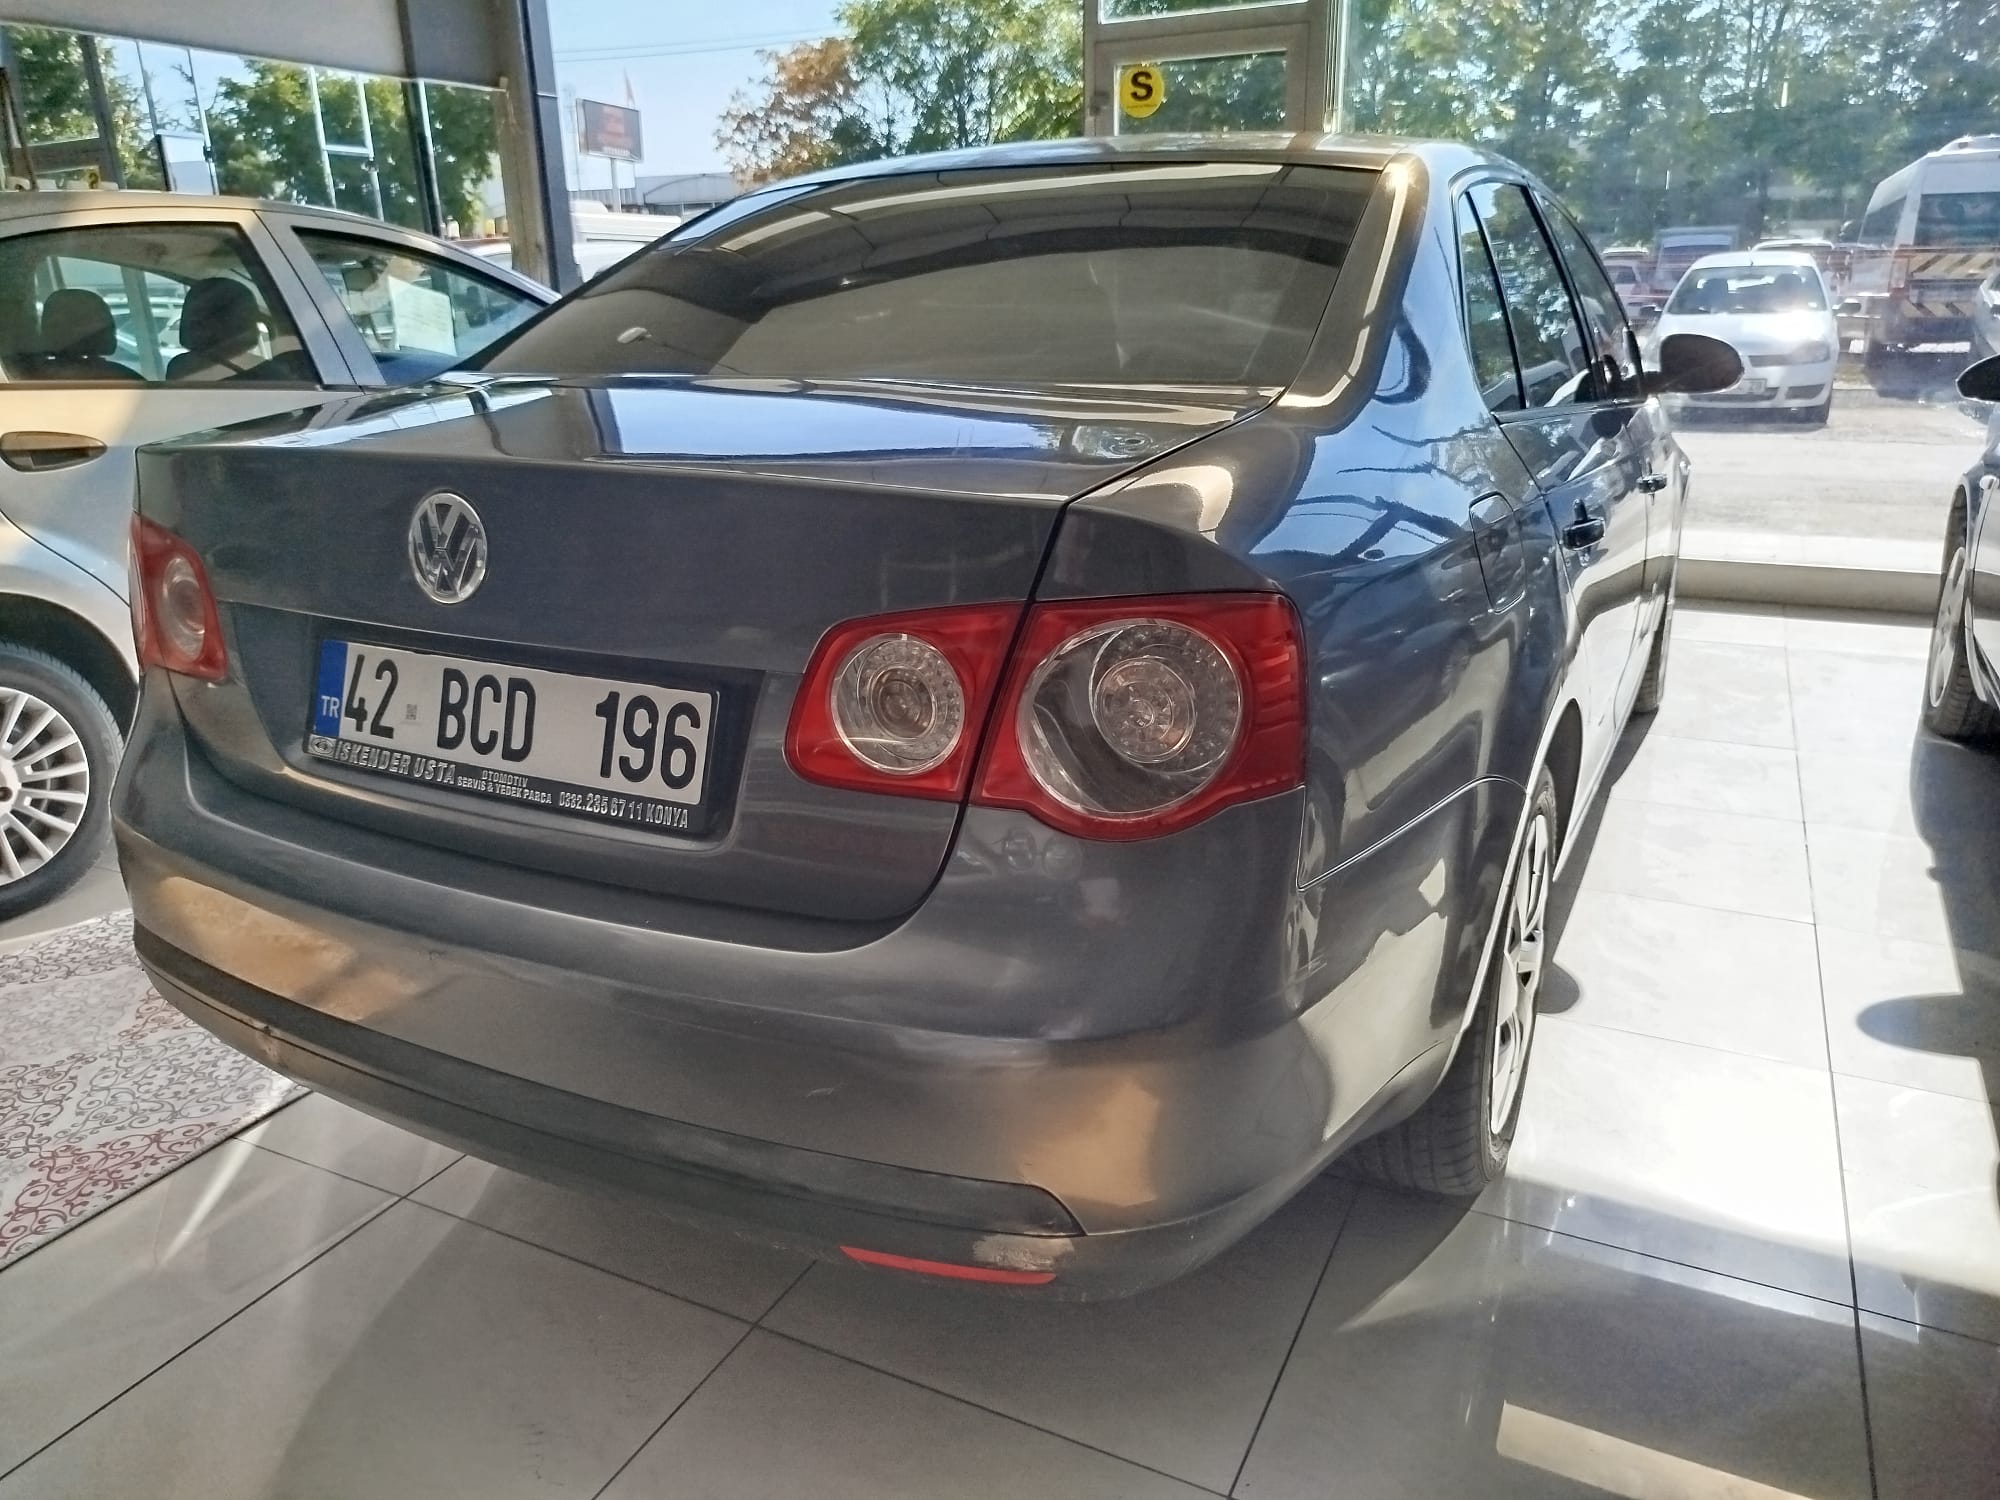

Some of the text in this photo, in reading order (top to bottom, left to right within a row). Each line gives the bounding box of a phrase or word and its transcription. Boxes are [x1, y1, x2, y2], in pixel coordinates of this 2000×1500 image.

[1130, 71, 1153, 102] S
[321, 695, 341, 719] TR
[344, 654, 701, 790] 42 BCD 196
[413, 757, 456, 785] USTA
[495, 783, 523, 798] YEDEK
[628, 801, 643, 820] 11
[645, 803, 688, 829] KONYA
